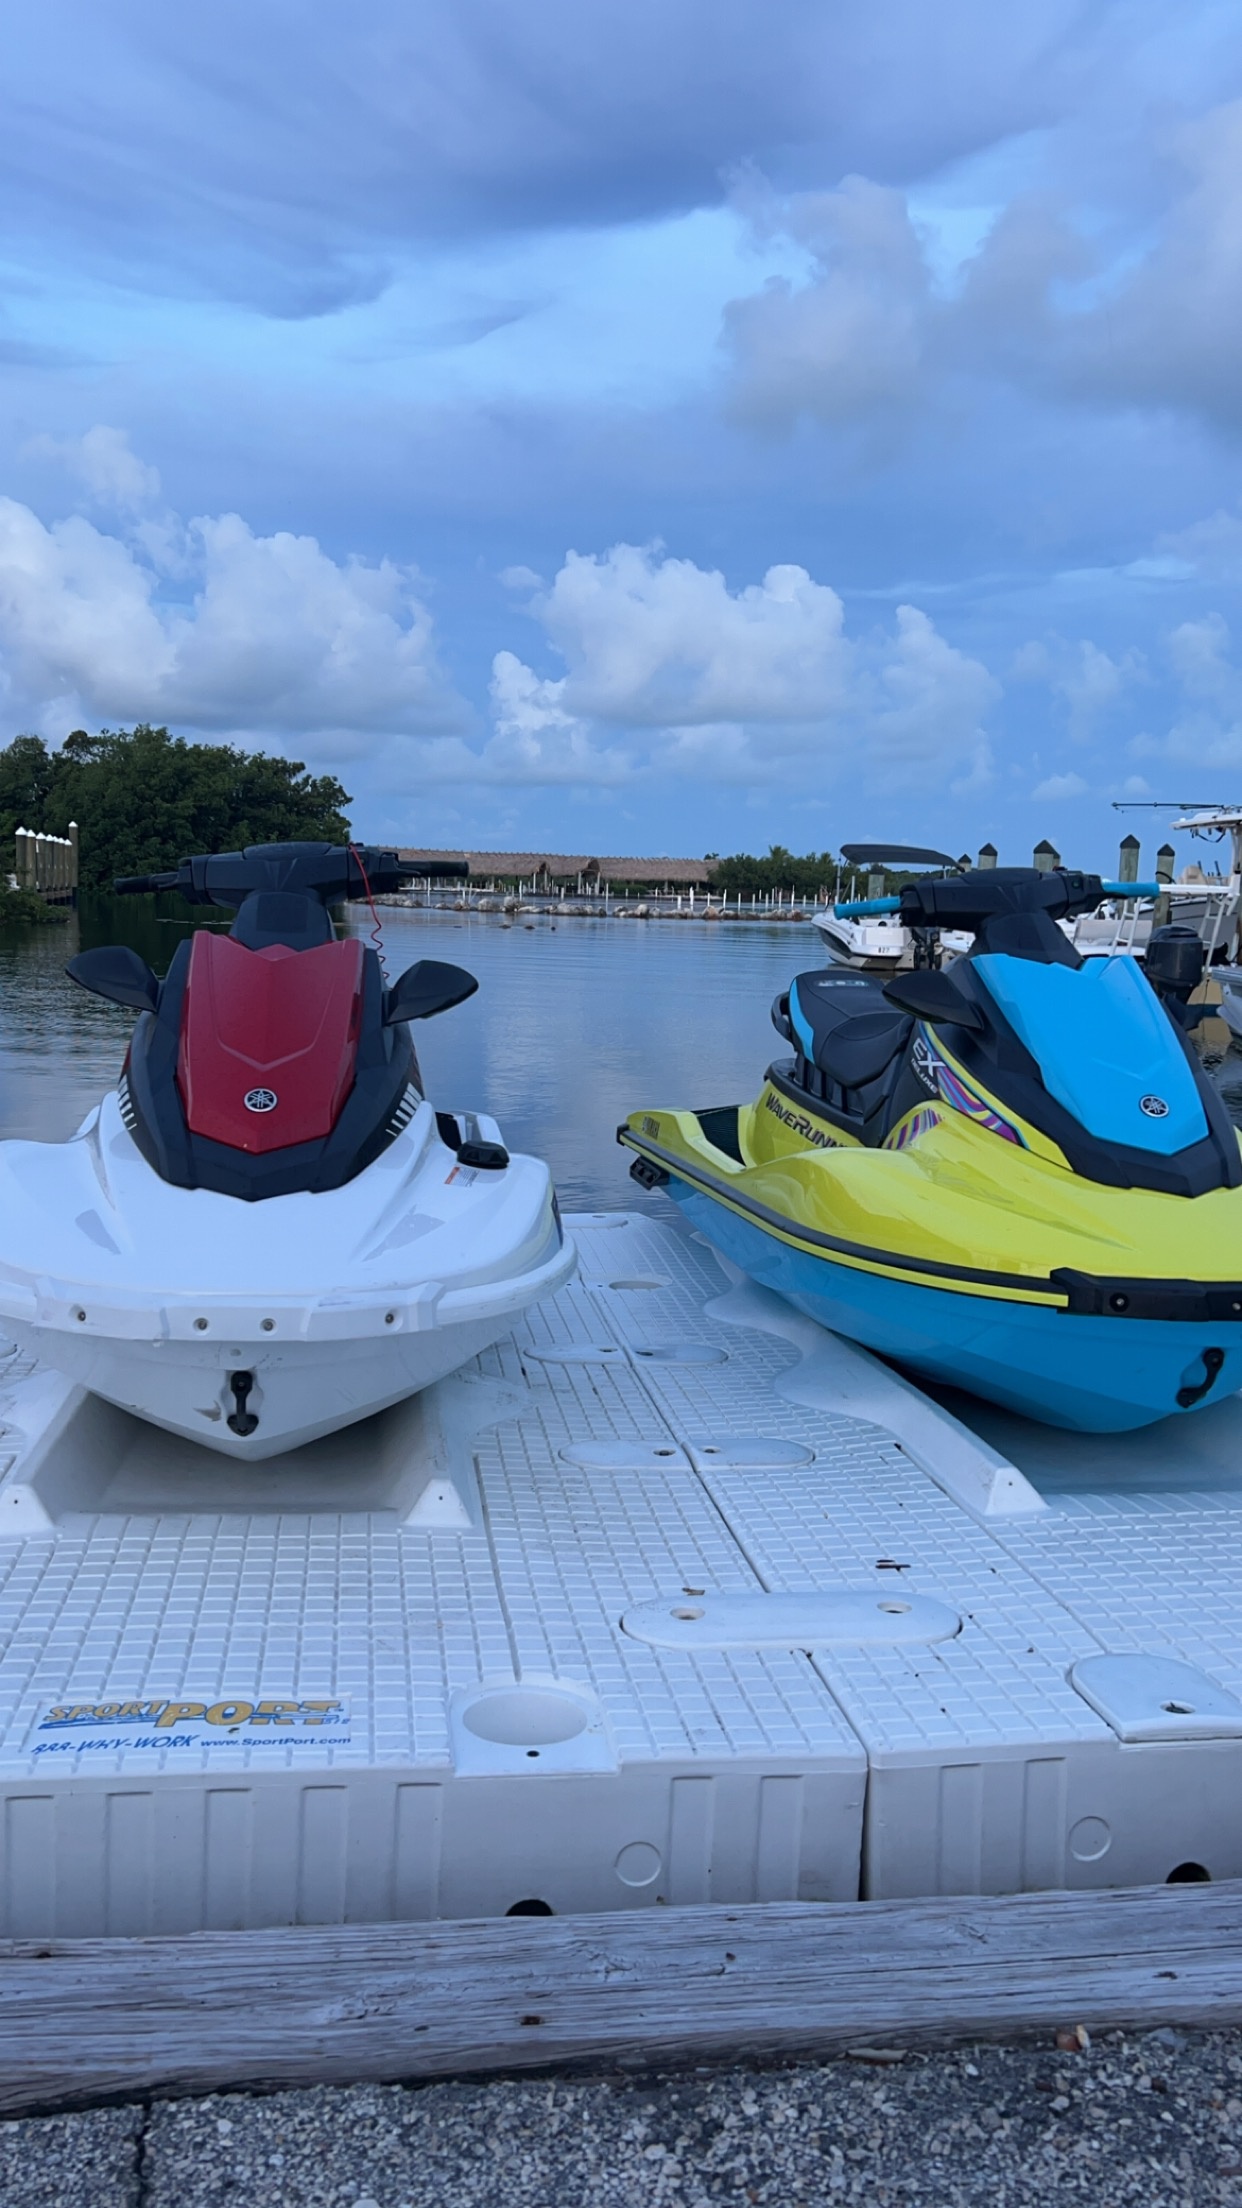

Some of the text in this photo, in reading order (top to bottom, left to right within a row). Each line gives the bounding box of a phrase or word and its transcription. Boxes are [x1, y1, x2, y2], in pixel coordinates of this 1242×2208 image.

[910, 1057, 939, 1094] DELUXE
[912, 1037, 947, 1077] EX
[200, 1737, 351, 1747] www.SportPort.com
